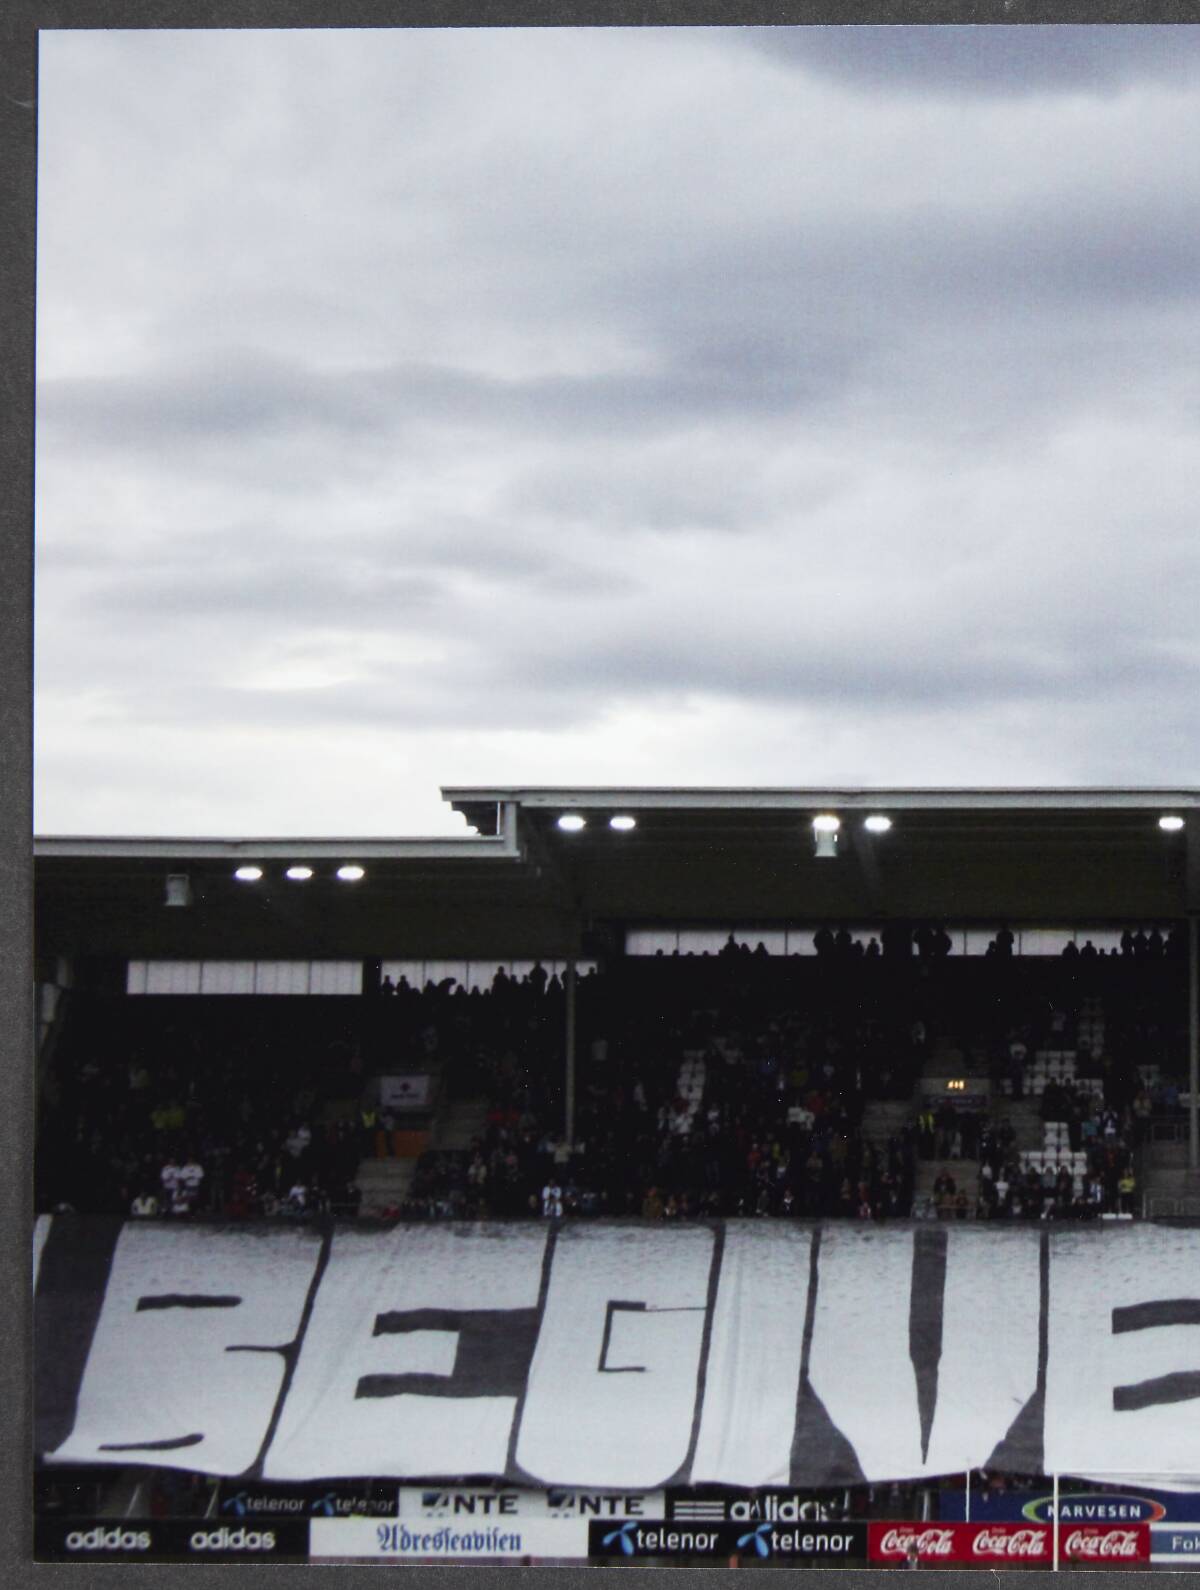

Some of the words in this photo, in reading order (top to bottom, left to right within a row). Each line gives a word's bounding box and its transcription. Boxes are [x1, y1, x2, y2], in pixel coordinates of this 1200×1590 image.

[247, 1495, 304, 1512] telenor
[453, 1495, 518, 1515] NTE
[578, 1495, 644, 1515] NTE
[1047, 1504, 1141, 1517] NARVESEN
[65, 1527, 151, 1549] adidas
[190, 1527, 276, 1549] adidas
[376, 1523, 522, 1552] Adresseavisen
[636, 1529, 719, 1550] telenor
[771, 1530, 854, 1551] telenor
[880, 1528, 955, 1555] Coca-Cola
[972, 1529, 1048, 1555] Coca-Cola
[1064, 1530, 1140, 1557] Coca-Cola
